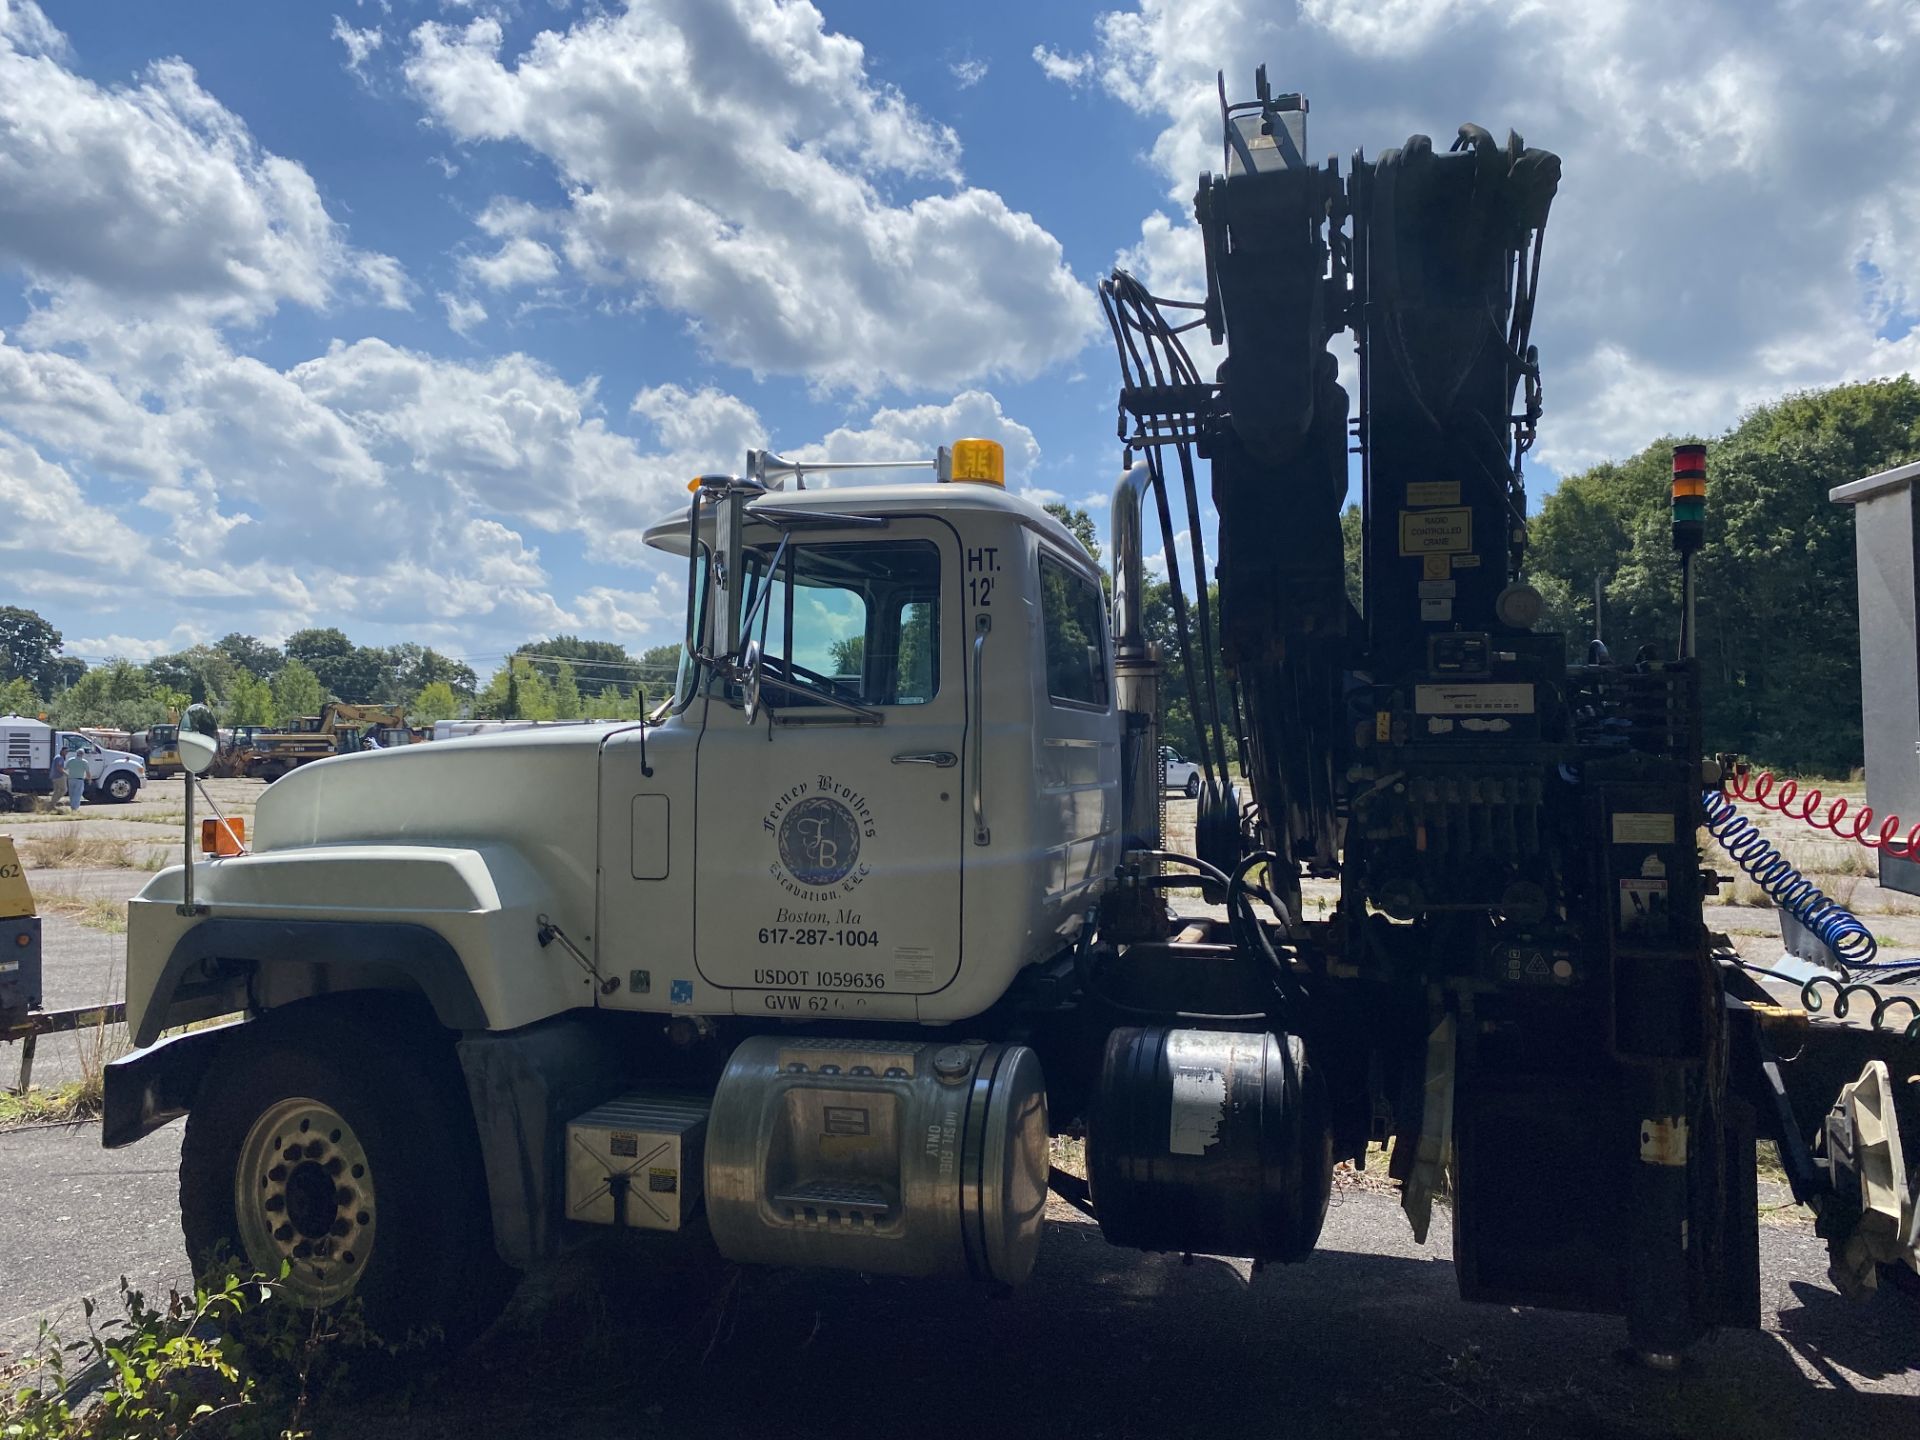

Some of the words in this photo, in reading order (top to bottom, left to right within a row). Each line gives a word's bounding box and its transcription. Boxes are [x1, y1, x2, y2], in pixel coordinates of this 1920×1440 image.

[1410, 526, 1462, 537] CONTROLLED
[1423, 537, 1449, 546] CRANE
[968, 548, 1001, 572] HT.
[763, 782, 808, 838] Feeney
[817, 774, 877, 839] Brothers
[776, 907, 831, 926] Boston,
[836, 908, 862, 925] Ma
[758, 928, 880, 947] 617-287-1004
[754, 968, 809, 986] USDOT
[816, 970, 886, 989] 1059636
[764, 995, 801, 1010] GVW
[925, 1124, 941, 1158] ONLY
